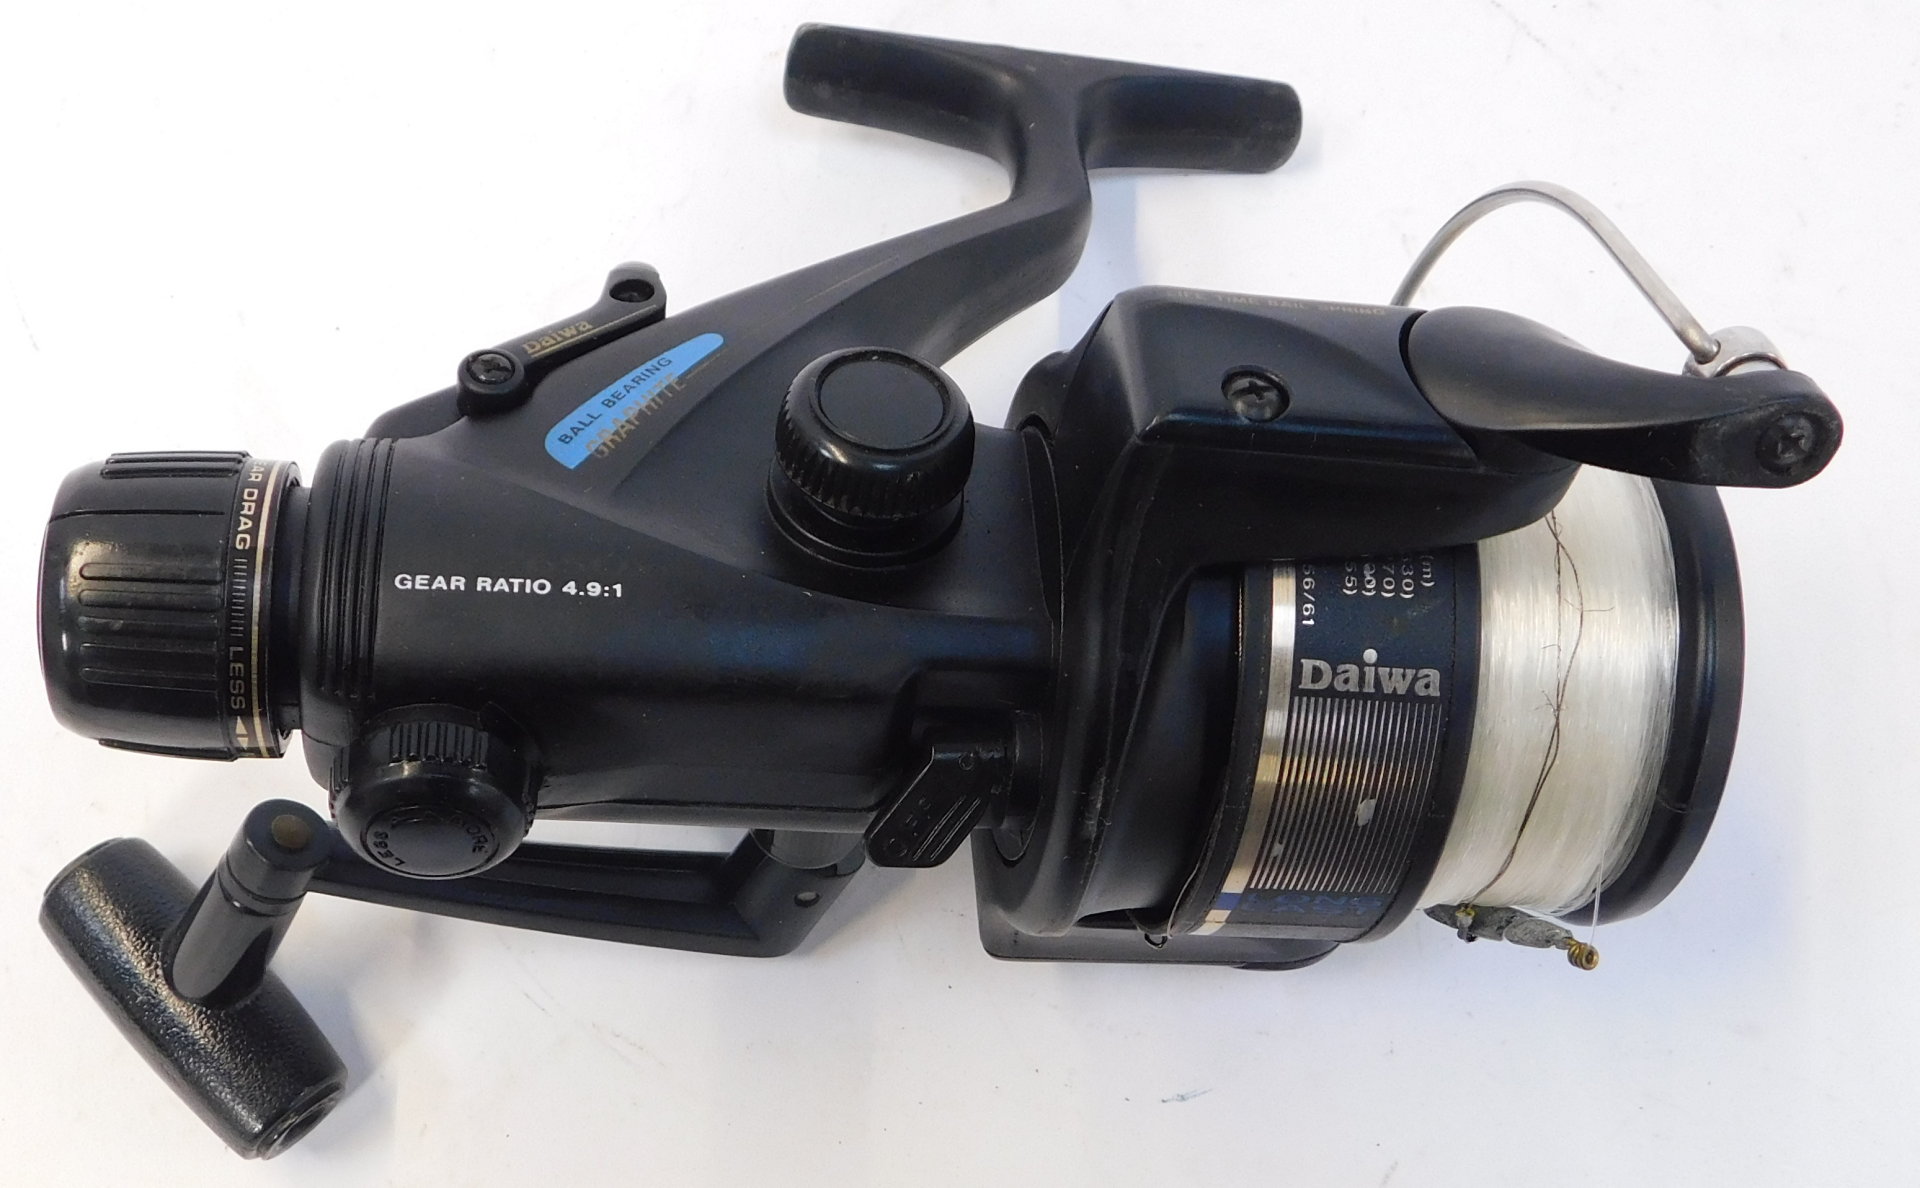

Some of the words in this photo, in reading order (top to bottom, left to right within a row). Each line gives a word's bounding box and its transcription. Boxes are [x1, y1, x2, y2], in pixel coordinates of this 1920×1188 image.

[522, 320, 594, 354] Daiwa
[557, 412, 603, 445] BALL
[601, 356, 673, 409] BEARING
[585, 372, 688, 459] GRAPHITE
[235, 487, 259, 550] DRAG
[394, 573, 466, 591] GEAR
[476, 576, 552, 595] RATIO
[561, 580, 623, 598] 4.9:1
[229, 646, 246, 710] LESS
[1298, 648, 1441, 697] Daiwa
